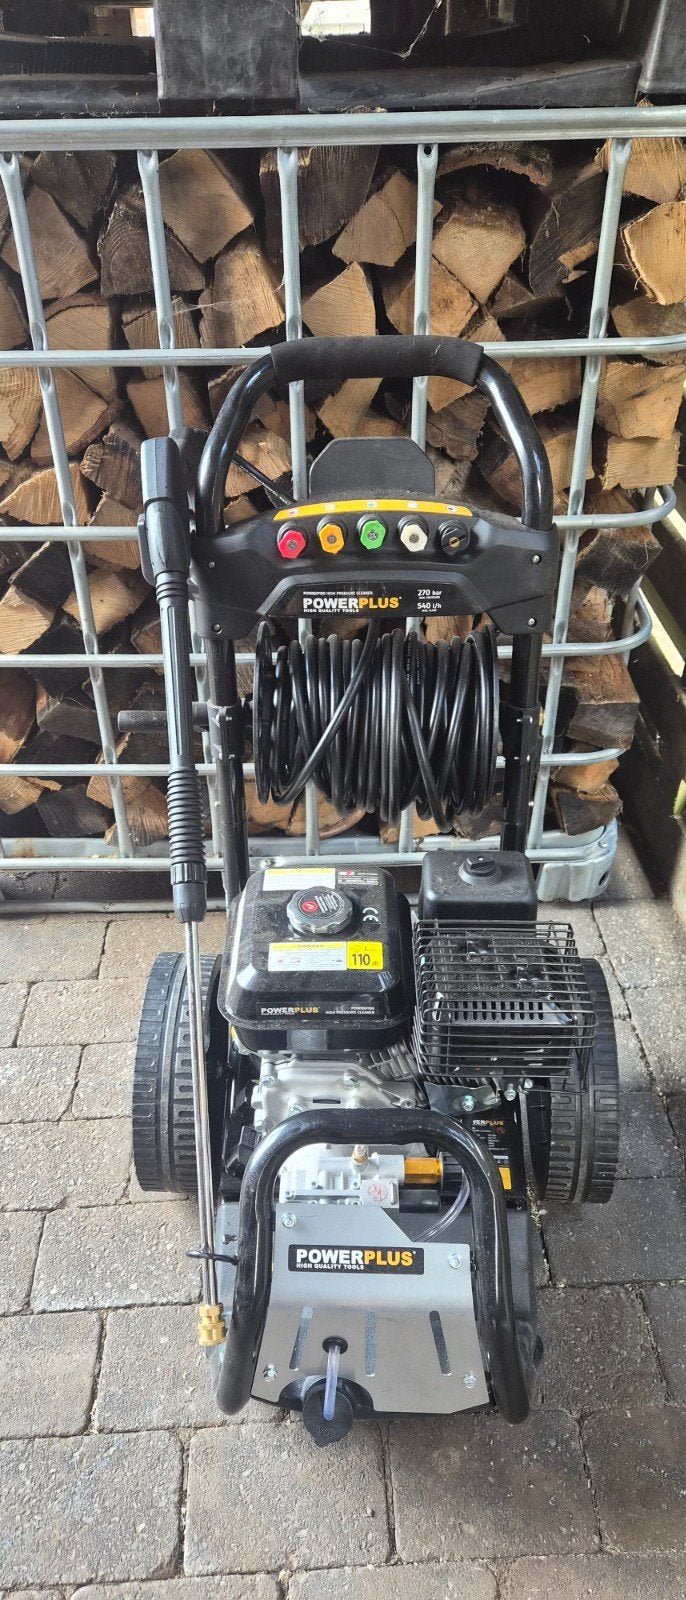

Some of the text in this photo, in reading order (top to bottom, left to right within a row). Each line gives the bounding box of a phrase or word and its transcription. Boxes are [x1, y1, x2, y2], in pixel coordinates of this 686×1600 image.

[303, 597, 400, 609] POWERPLUS
[351, 953, 371, 967] 110
[296, 1248, 413, 1267] POWERPLUS
